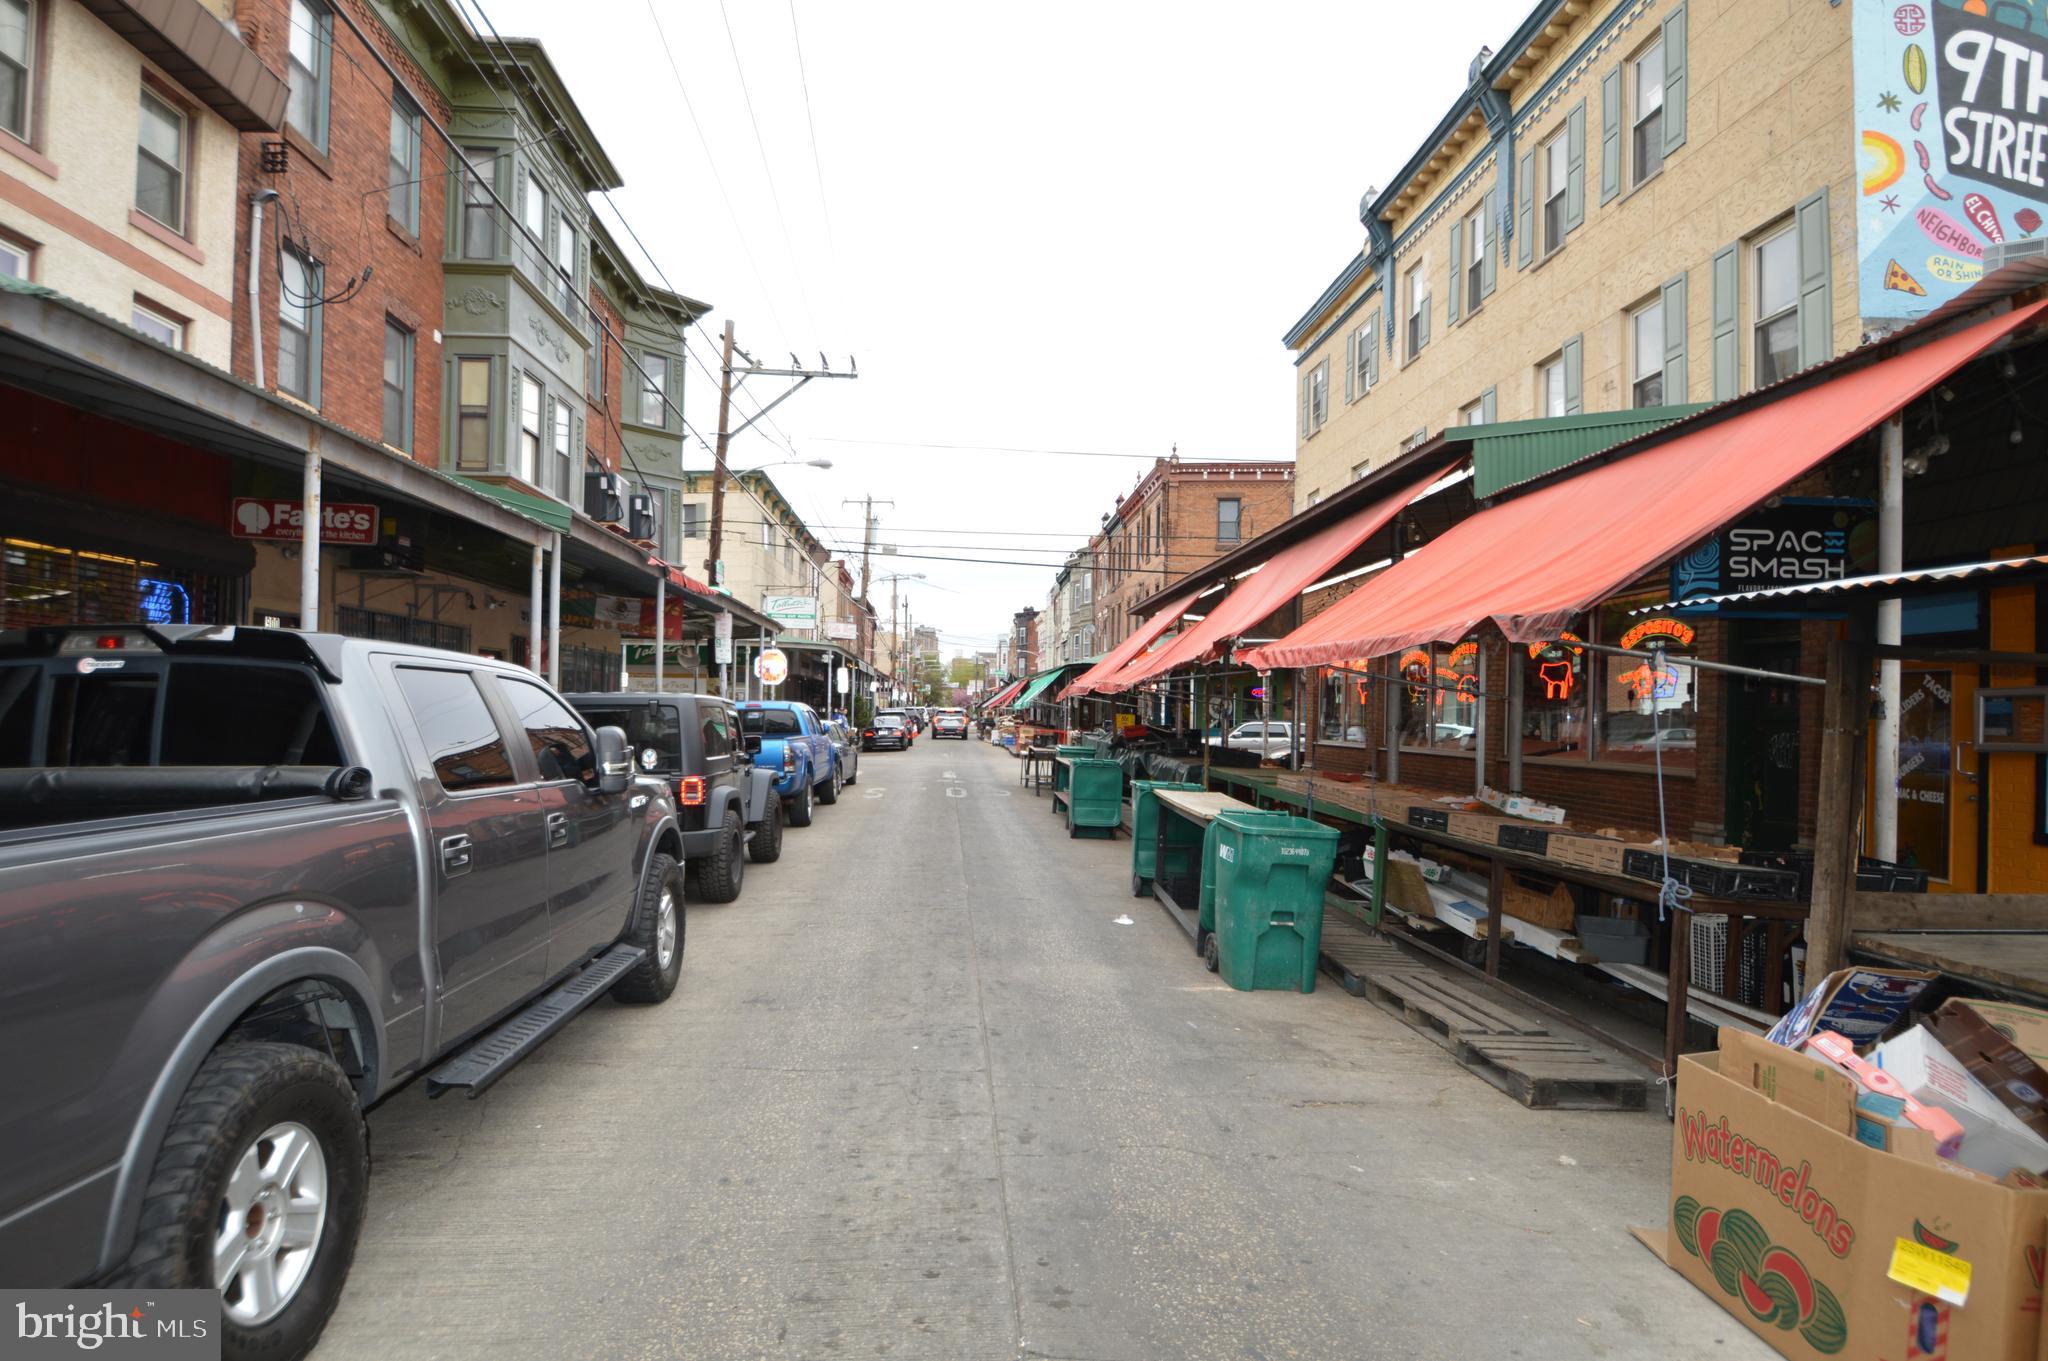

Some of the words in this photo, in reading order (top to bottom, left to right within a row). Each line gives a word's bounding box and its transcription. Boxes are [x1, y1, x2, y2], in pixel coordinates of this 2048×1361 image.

[1944, 29, 2048, 115] 9TH
[1965, 195, 1983, 214] EL
[1917, 209, 1984, 257] NEIGHBOR
[1933, 256, 1965, 270] RAIN
[1936, 268, 1952, 278] OR
[1955, 270, 1984, 280] SHIN
[273, 503, 371, 531] Fate's
[1728, 528, 1846, 554] SPACE
[1620, 619, 1695, 650] ESPOSITO'S
[1900, 688, 1926, 714] LIDERS
[1922, 673, 1952, 705] TACOS
[1898, 752, 1926, 777] URGERS
[1919, 790, 1945, 804] CHEESE
[1679, 1107, 1856, 1259] Watermelons
